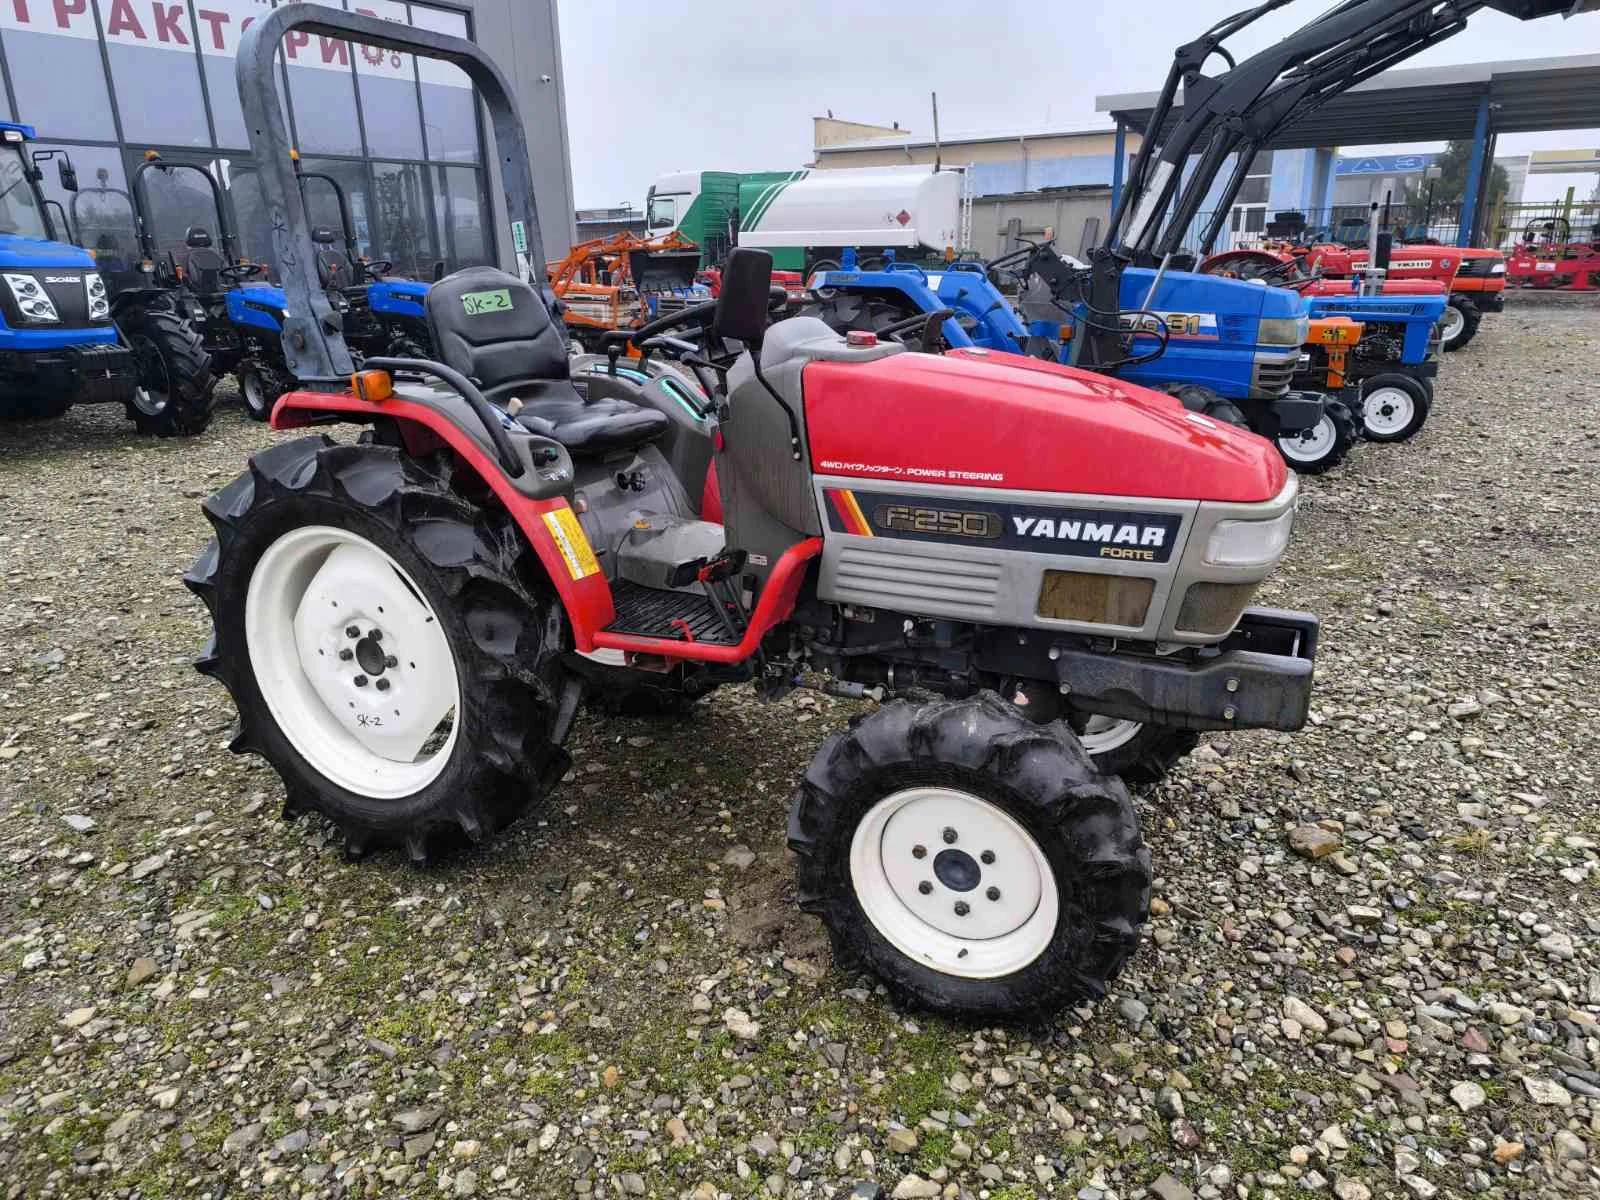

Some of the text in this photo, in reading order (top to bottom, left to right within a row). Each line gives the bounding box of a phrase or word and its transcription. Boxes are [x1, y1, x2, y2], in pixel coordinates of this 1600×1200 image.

[463, 294, 509, 313] SK-2
[1167, 313, 1200, 335] 31
[907, 467, 946, 478] POWER
[948, 470, 1004, 481] STEERING
[1012, 516, 1167, 547] YANMAR
[1100, 546, 1154, 560] FORTE
